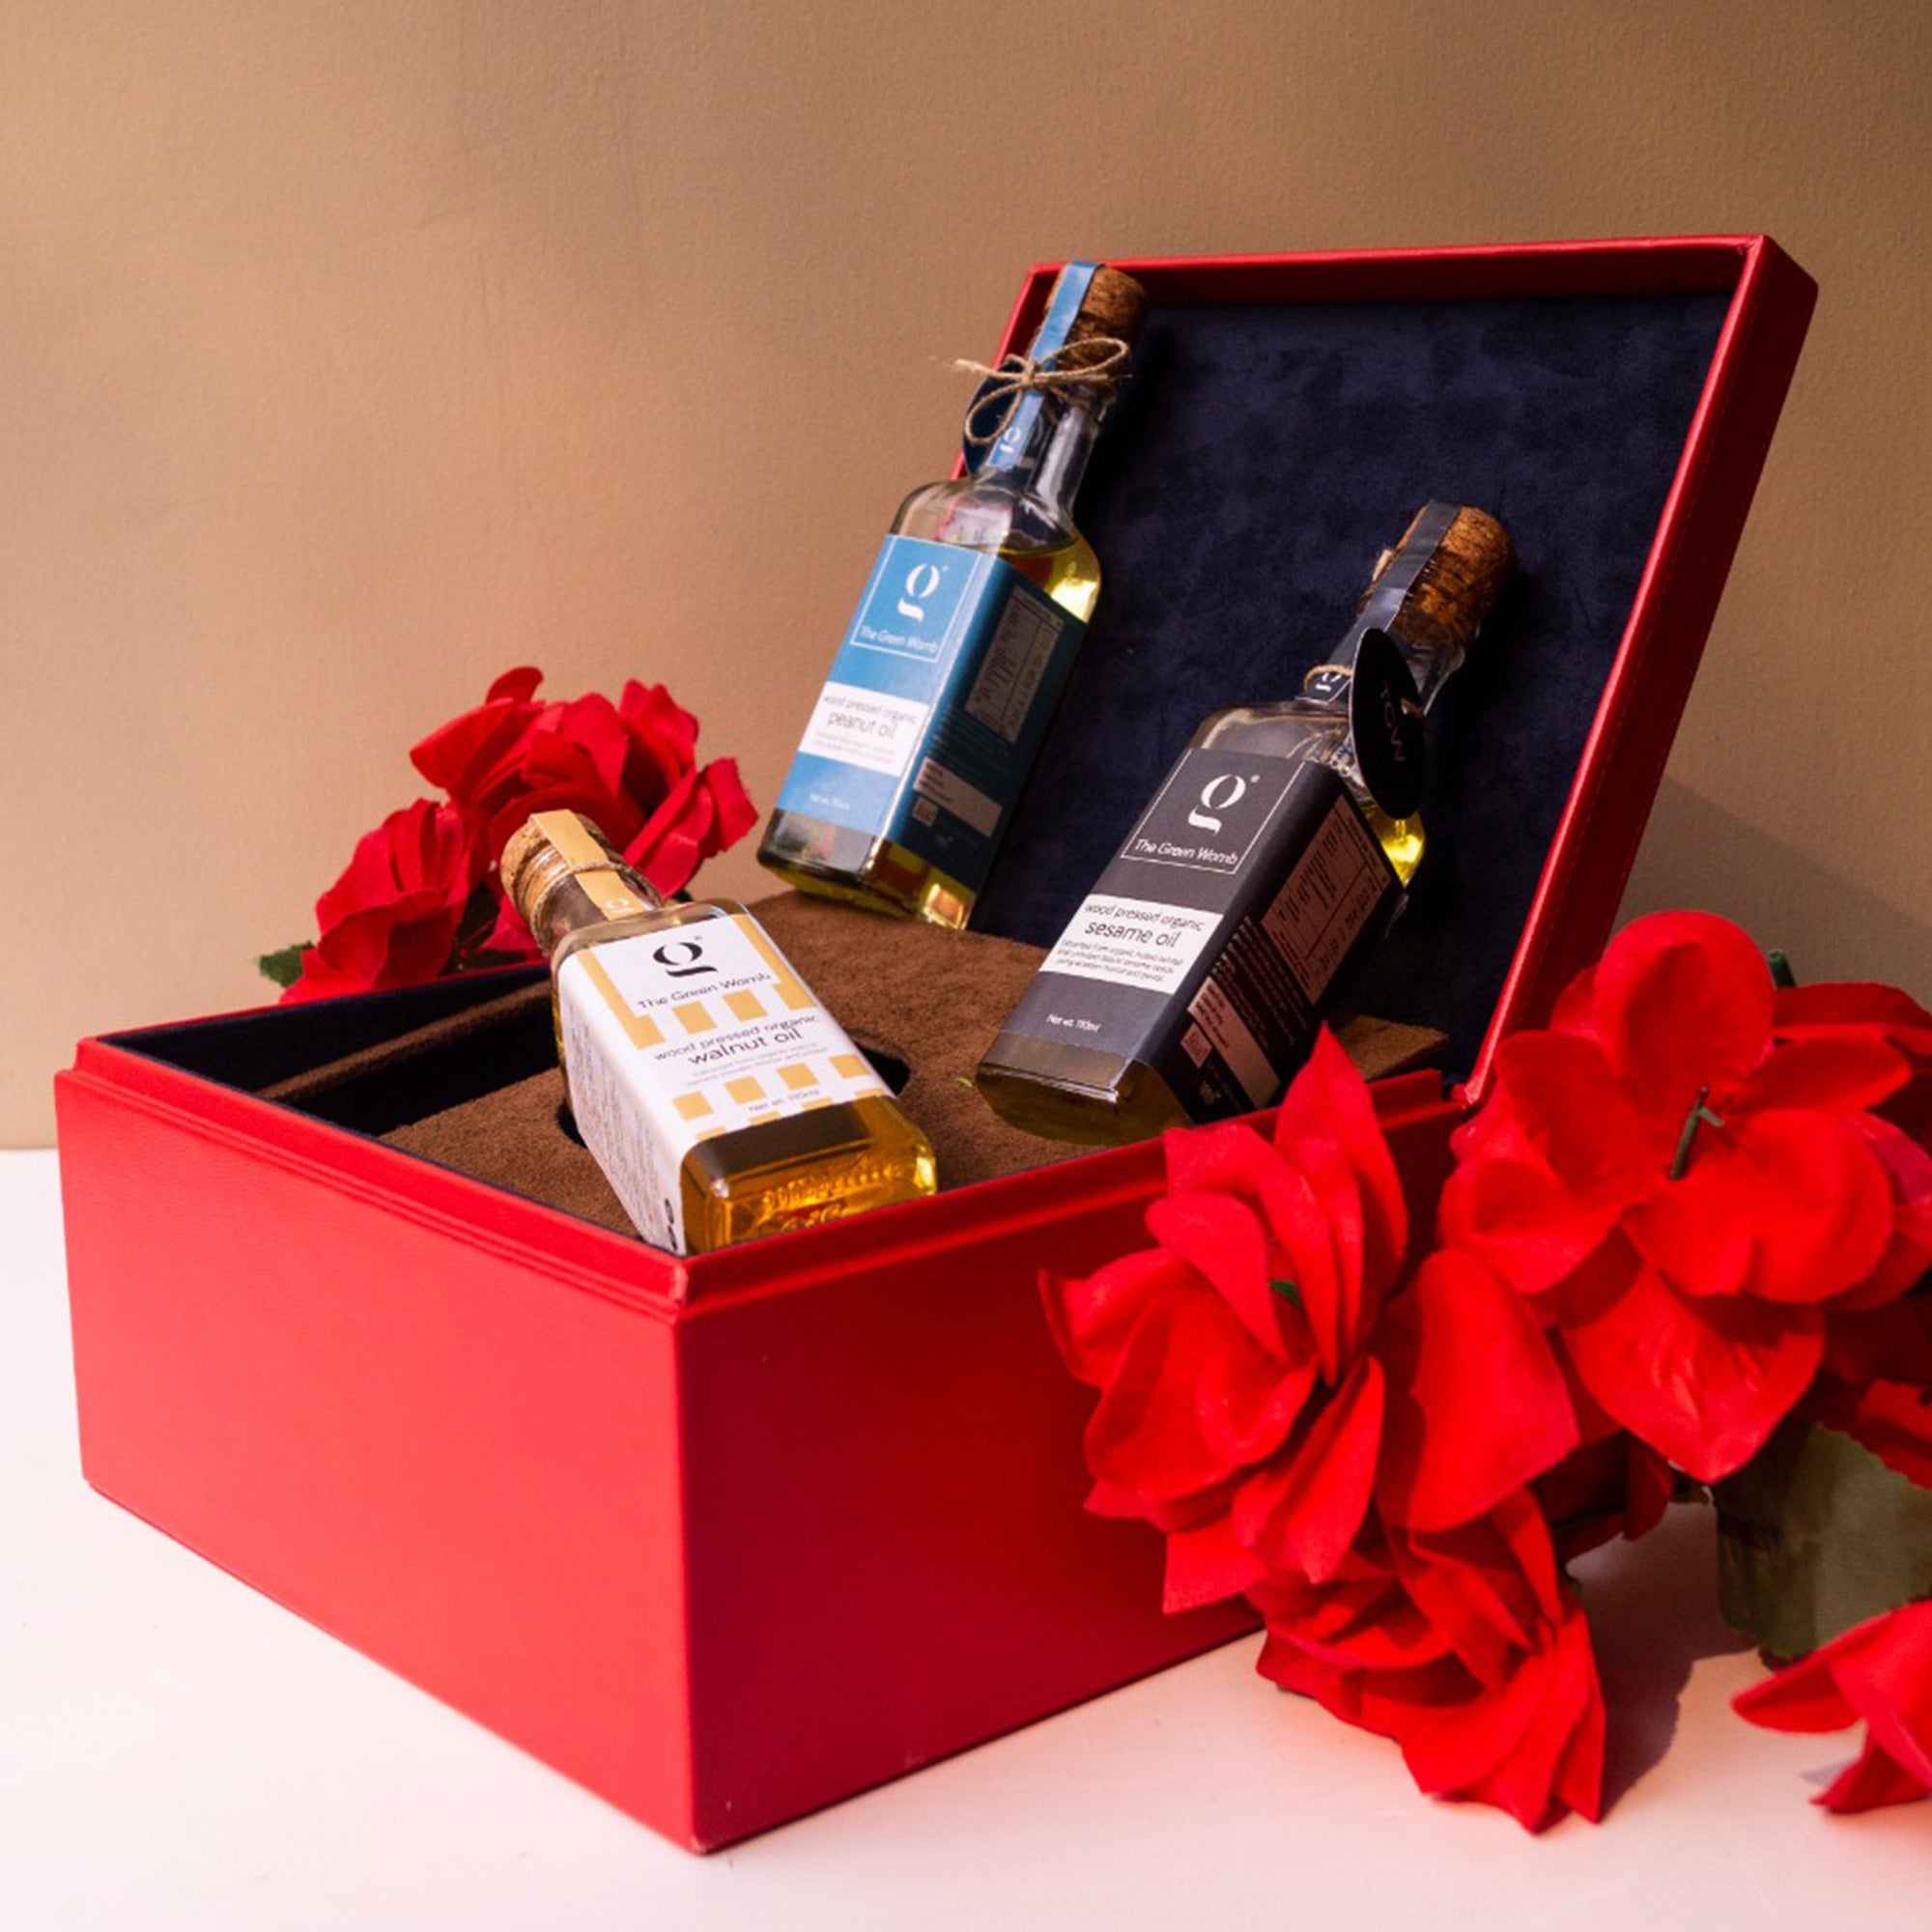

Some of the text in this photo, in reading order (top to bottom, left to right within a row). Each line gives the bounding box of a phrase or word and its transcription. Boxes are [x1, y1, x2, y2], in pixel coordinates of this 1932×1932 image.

[860, 625, 939, 654] The Green Womb
[823, 694, 845, 706] wood
[827, 711, 899, 739] peanut oil
[1135, 838, 1239, 866] The Green Womb
[1085, 902, 1206, 932] wood pressed organic
[1085, 921, 1153, 945] sesame
[1154, 929, 1182, 949] oil
[638, 972, 772, 1009] The Green Womb
[653, 1042, 696, 1061] wood
[698, 1026, 760, 1050] pressed
[764, 1014, 820, 1032] organic
[688, 1036, 768, 1065] walnut
[773, 1027, 804, 1044] oil
